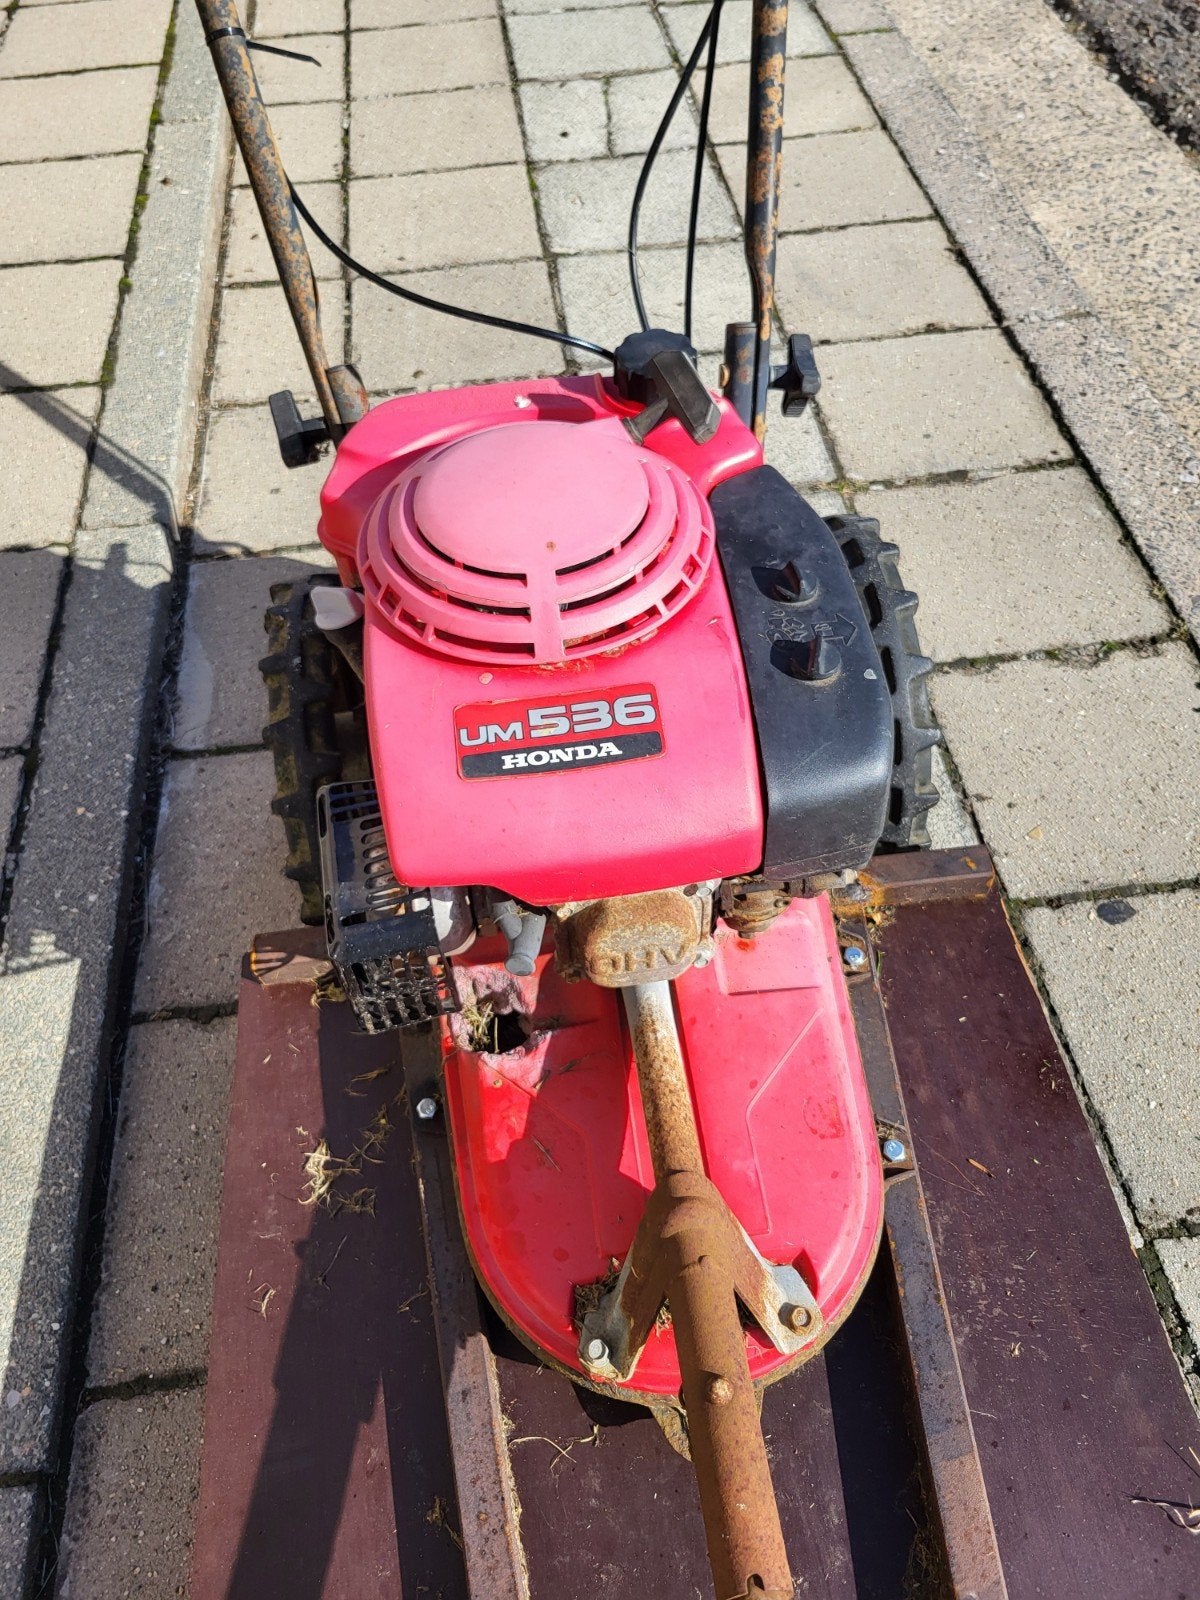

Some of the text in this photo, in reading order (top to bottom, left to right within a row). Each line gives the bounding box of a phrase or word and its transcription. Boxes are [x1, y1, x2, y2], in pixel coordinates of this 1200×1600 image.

[459, 694, 657, 746] UM 536
[502, 742, 622, 769] HONDA
